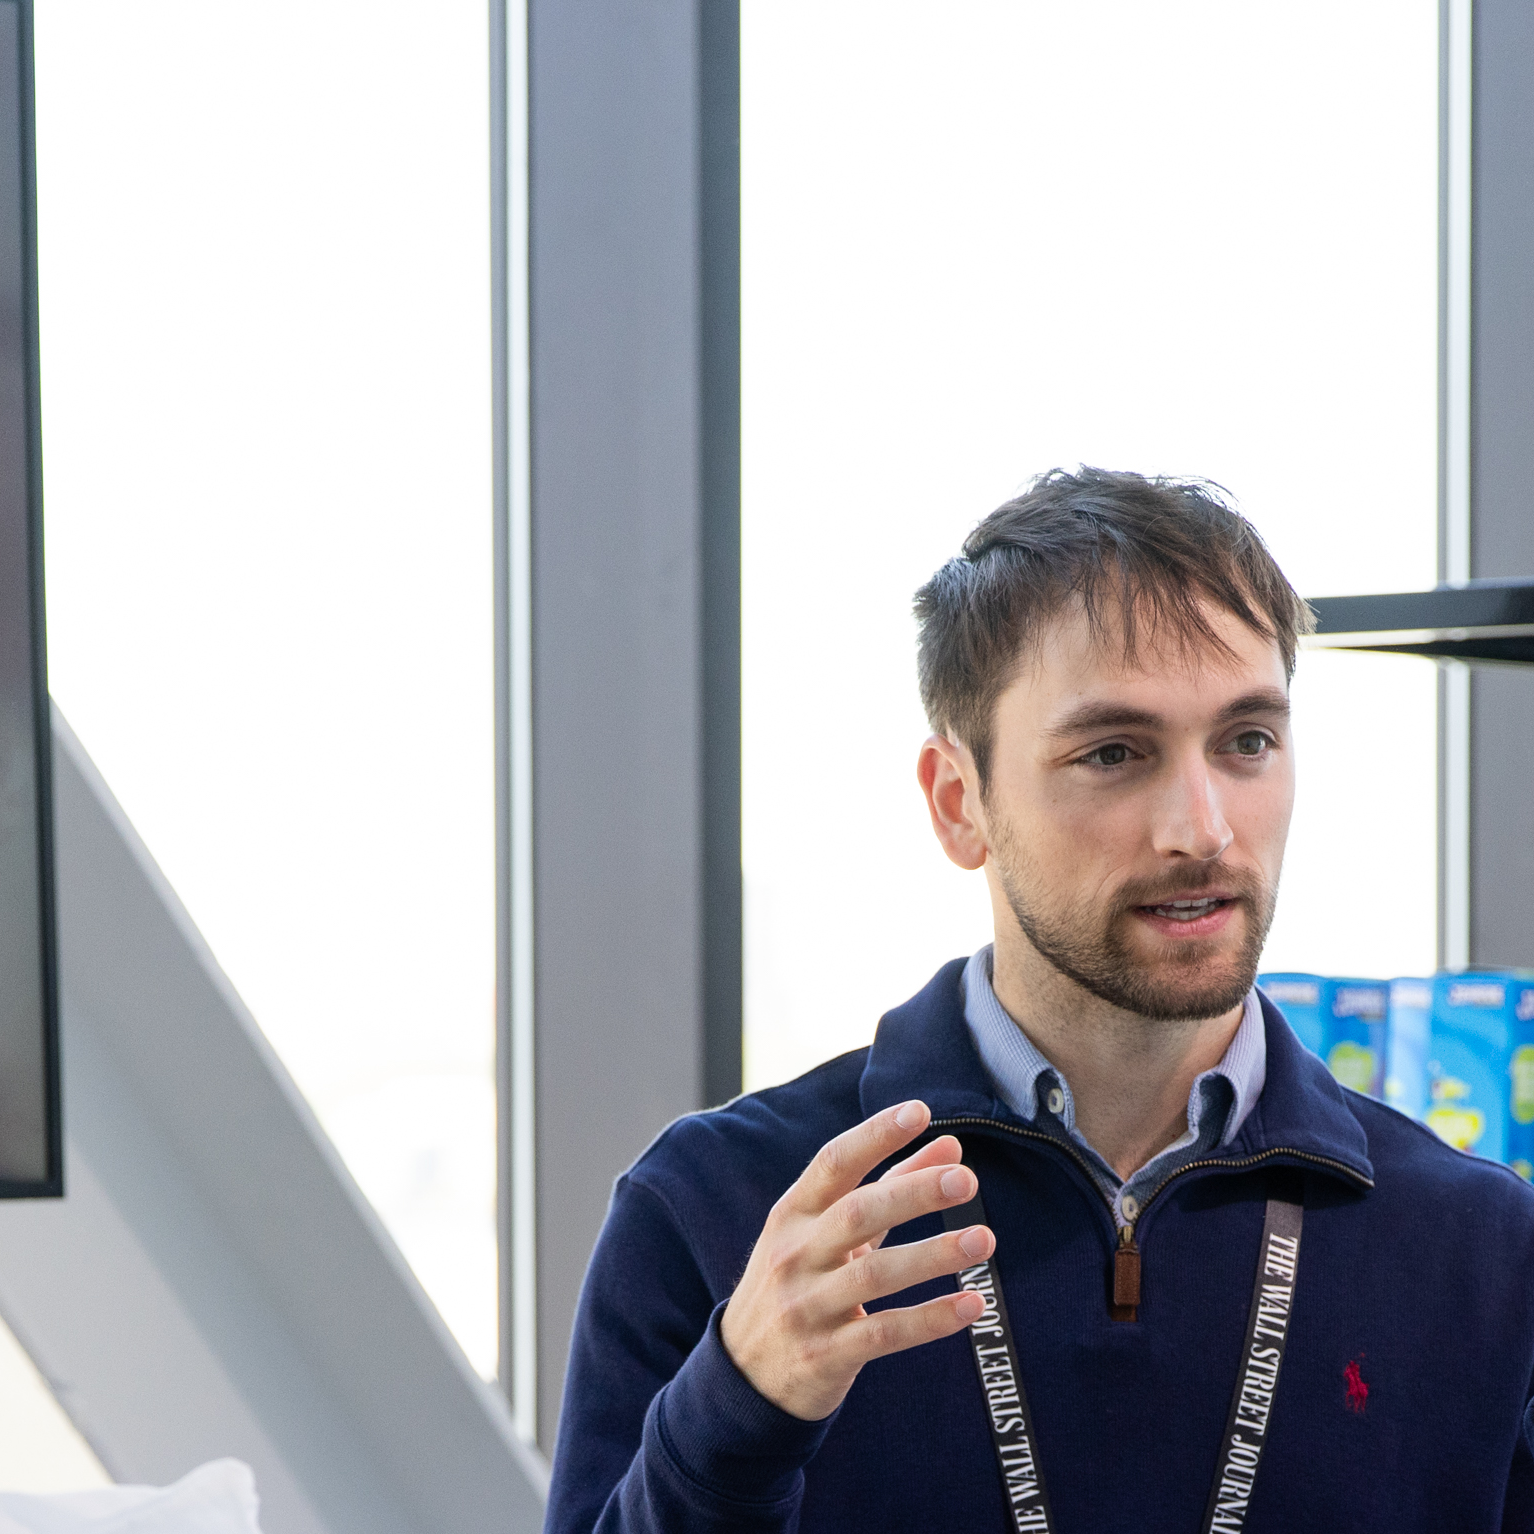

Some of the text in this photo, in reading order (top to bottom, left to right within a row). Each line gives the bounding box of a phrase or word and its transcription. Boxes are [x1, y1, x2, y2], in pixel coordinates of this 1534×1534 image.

[1264, 1233, 1299, 1283] THE
[958, 1260, 1005, 1338] JORN
[1253, 1283, 1293, 1341] WALL
[975, 1344, 1026, 1434] STREET
[1234, 1344, 1282, 1436] STREET
[999, 1435, 1041, 1504] WALL
